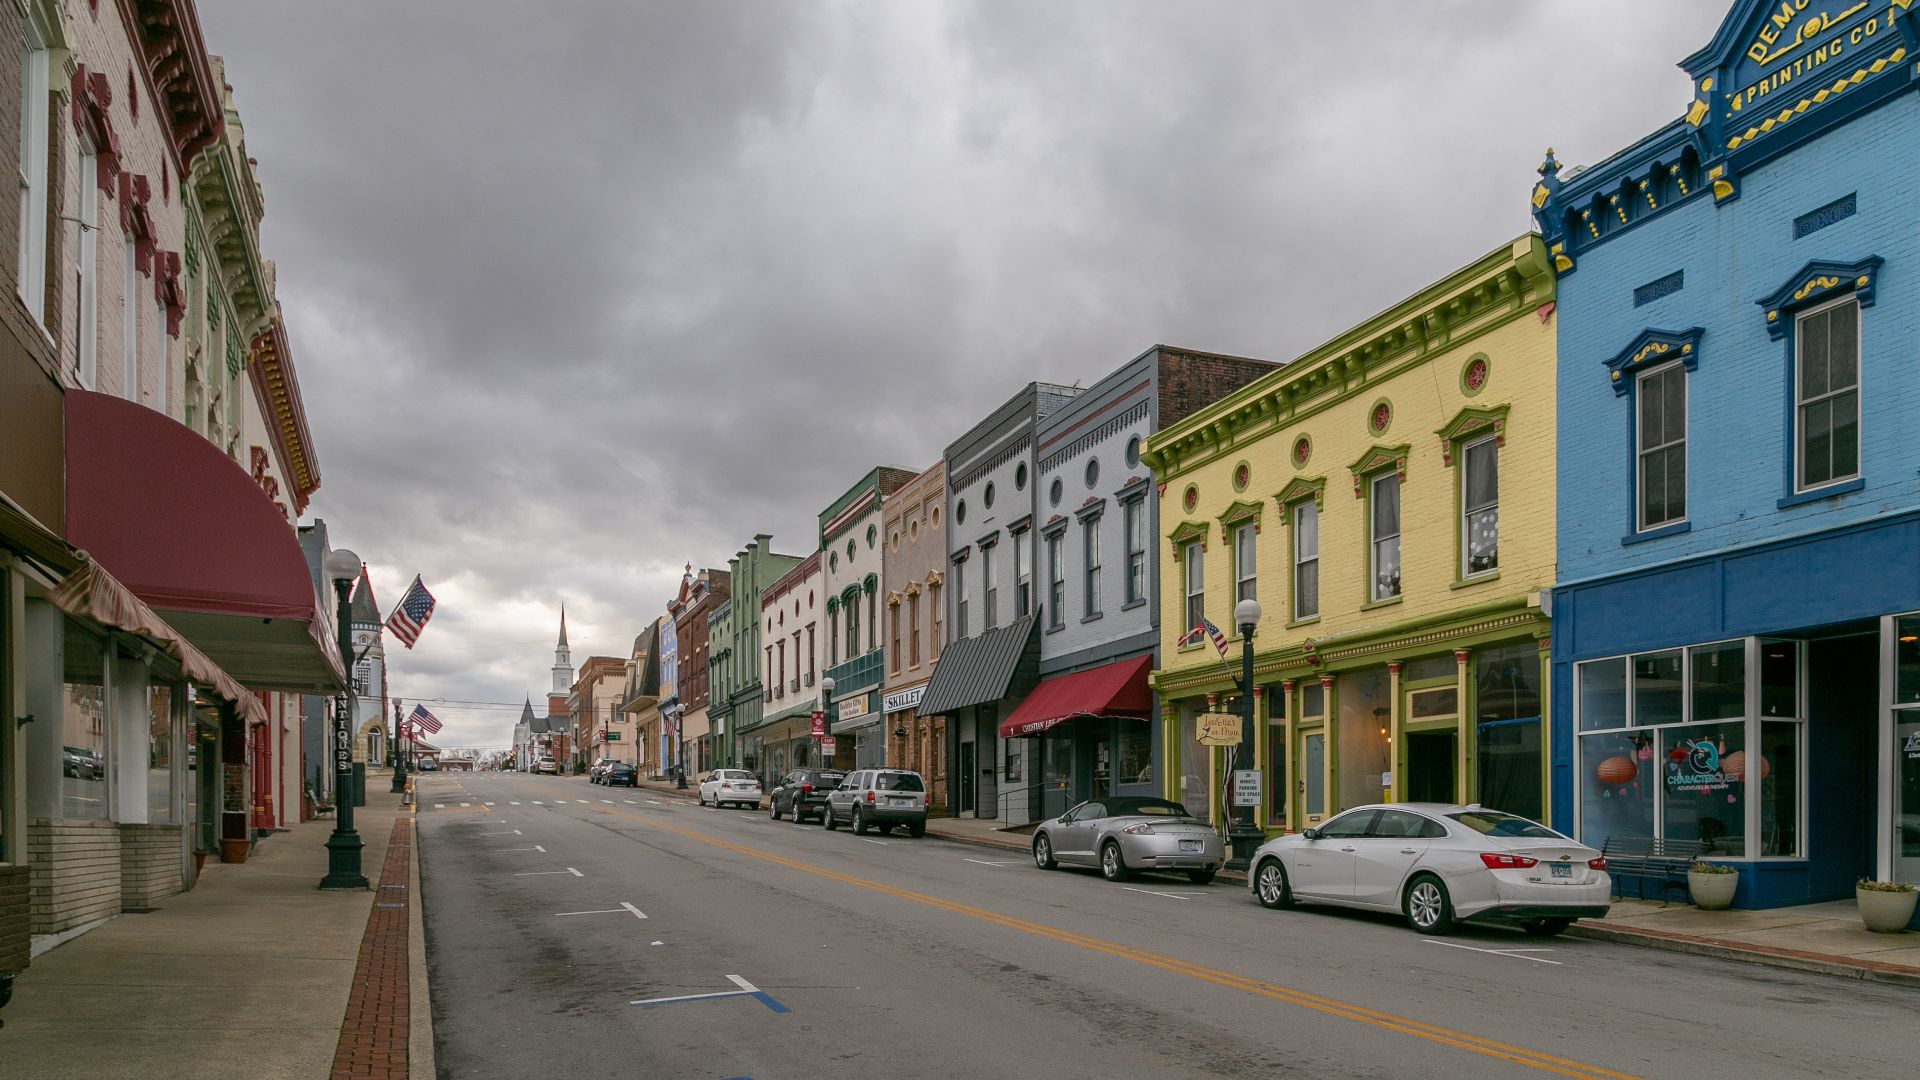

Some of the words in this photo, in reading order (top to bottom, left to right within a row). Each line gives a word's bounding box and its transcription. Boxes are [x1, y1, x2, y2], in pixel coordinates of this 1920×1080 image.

[1747, 39, 1842, 104] PRINTING
[888, 691, 920, 709] SKILLET
[1022, 721, 1044, 732] CHRISTIAN
